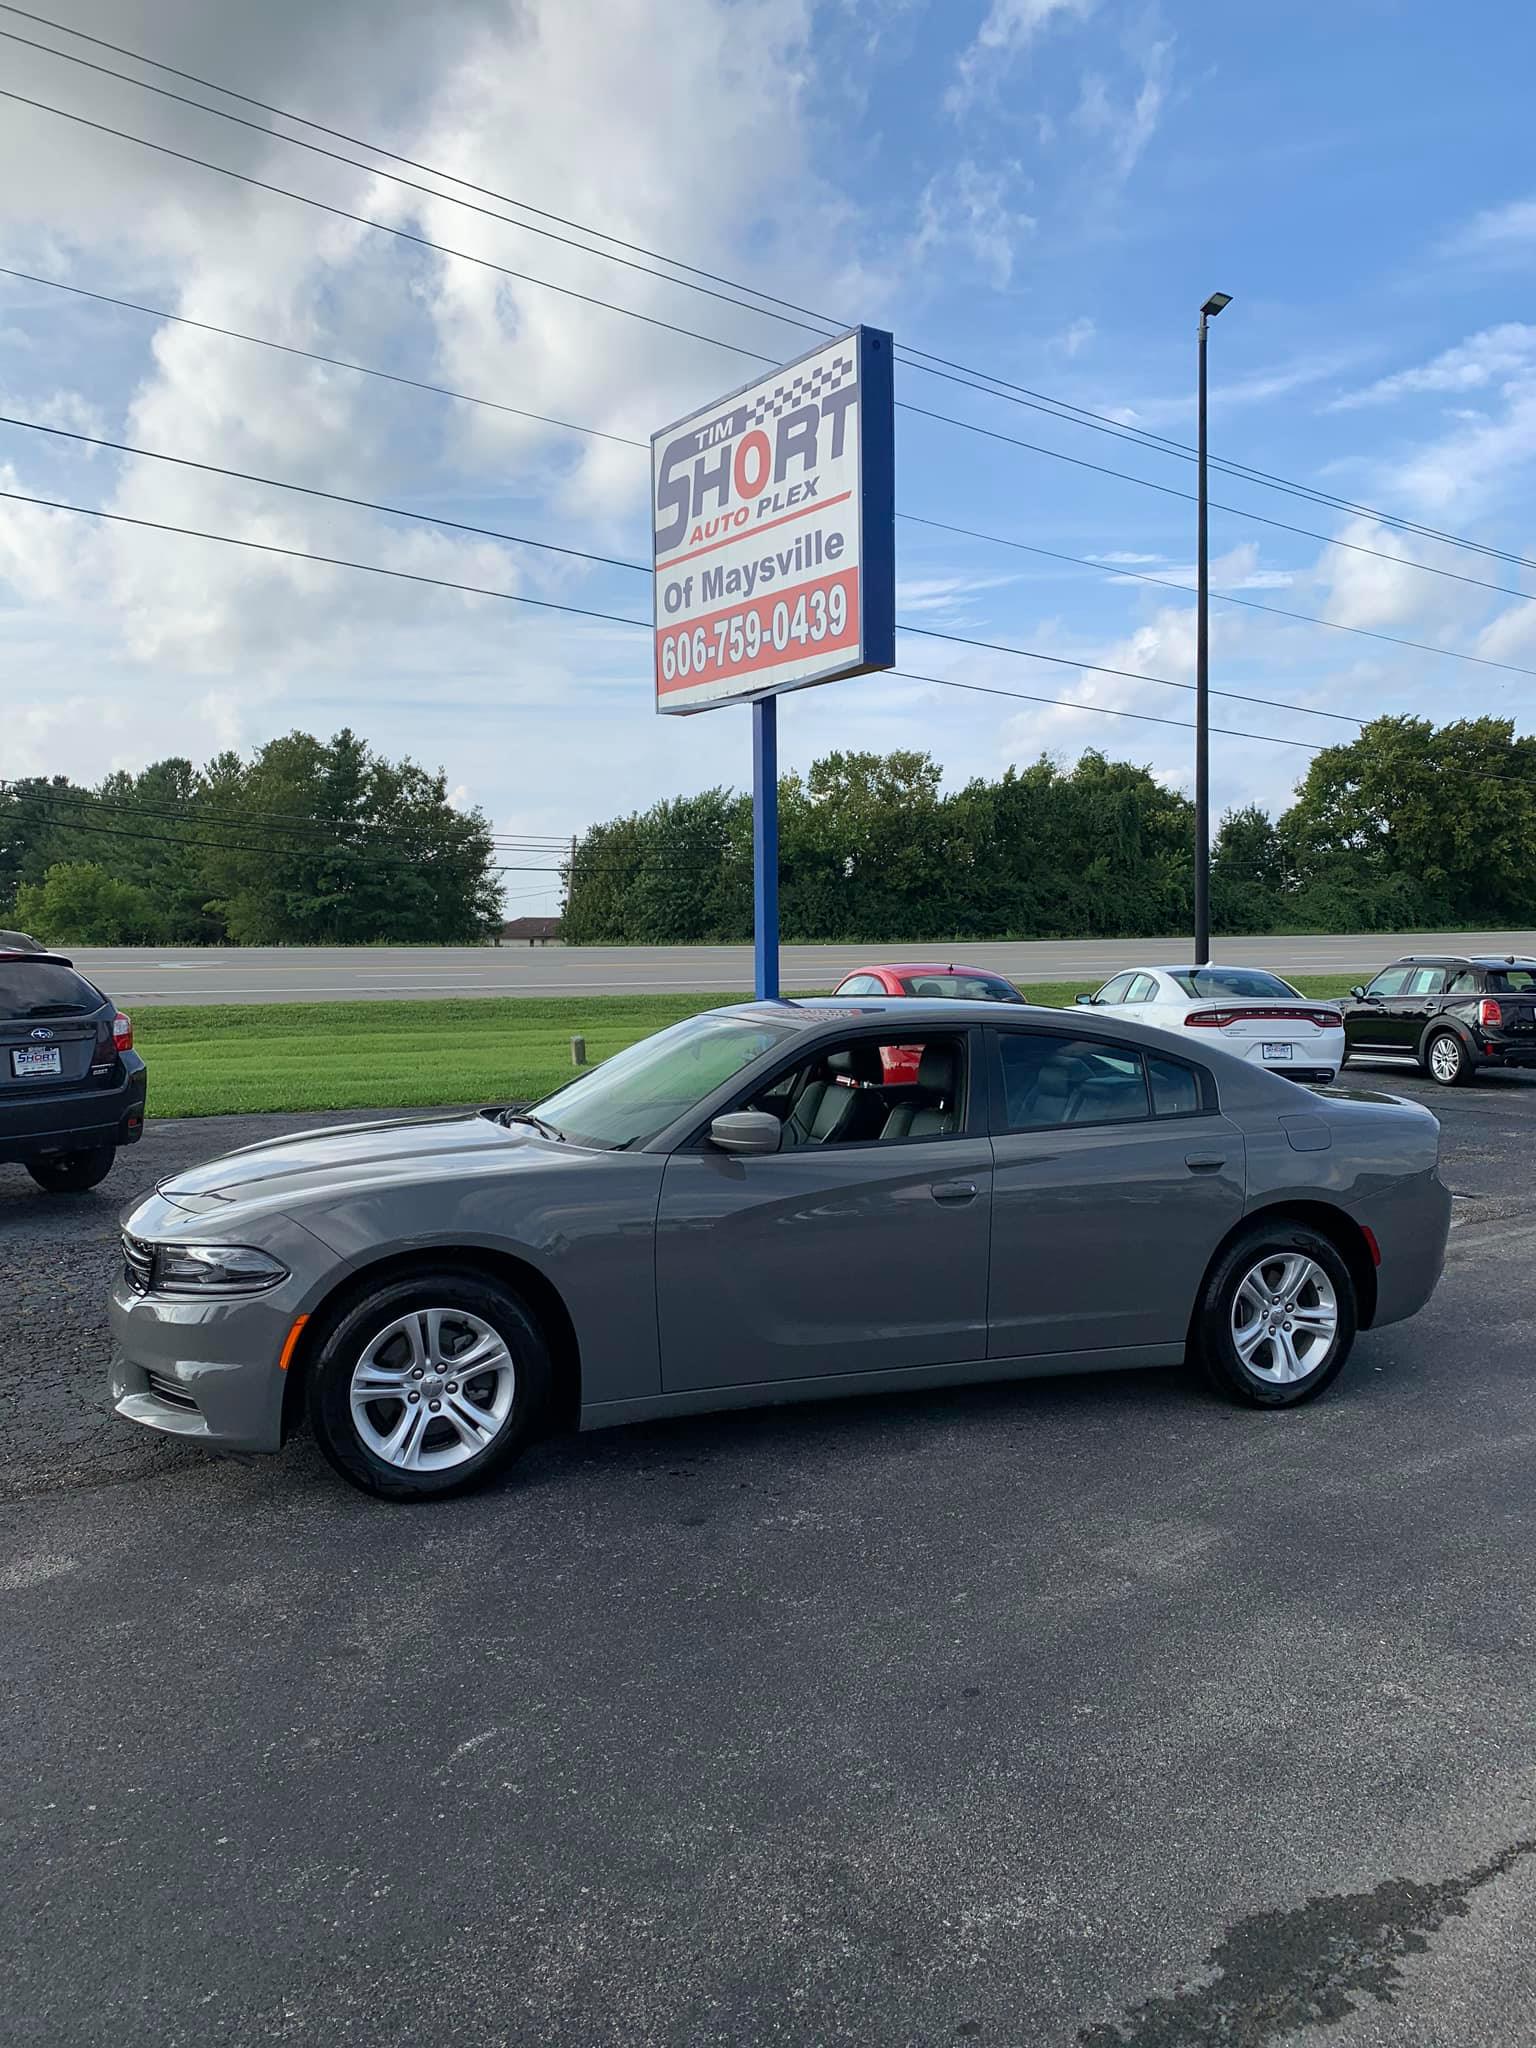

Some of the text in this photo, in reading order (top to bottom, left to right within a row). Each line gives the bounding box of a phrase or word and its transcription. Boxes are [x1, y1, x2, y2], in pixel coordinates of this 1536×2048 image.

[655, 383, 858, 555] SHORT
[695, 417, 734, 451] TIM
[689, 476, 821, 545] AUTO PLEX
[664, 530, 844, 614] Of Maysville
[662, 583, 848, 681] 606-759-0439
